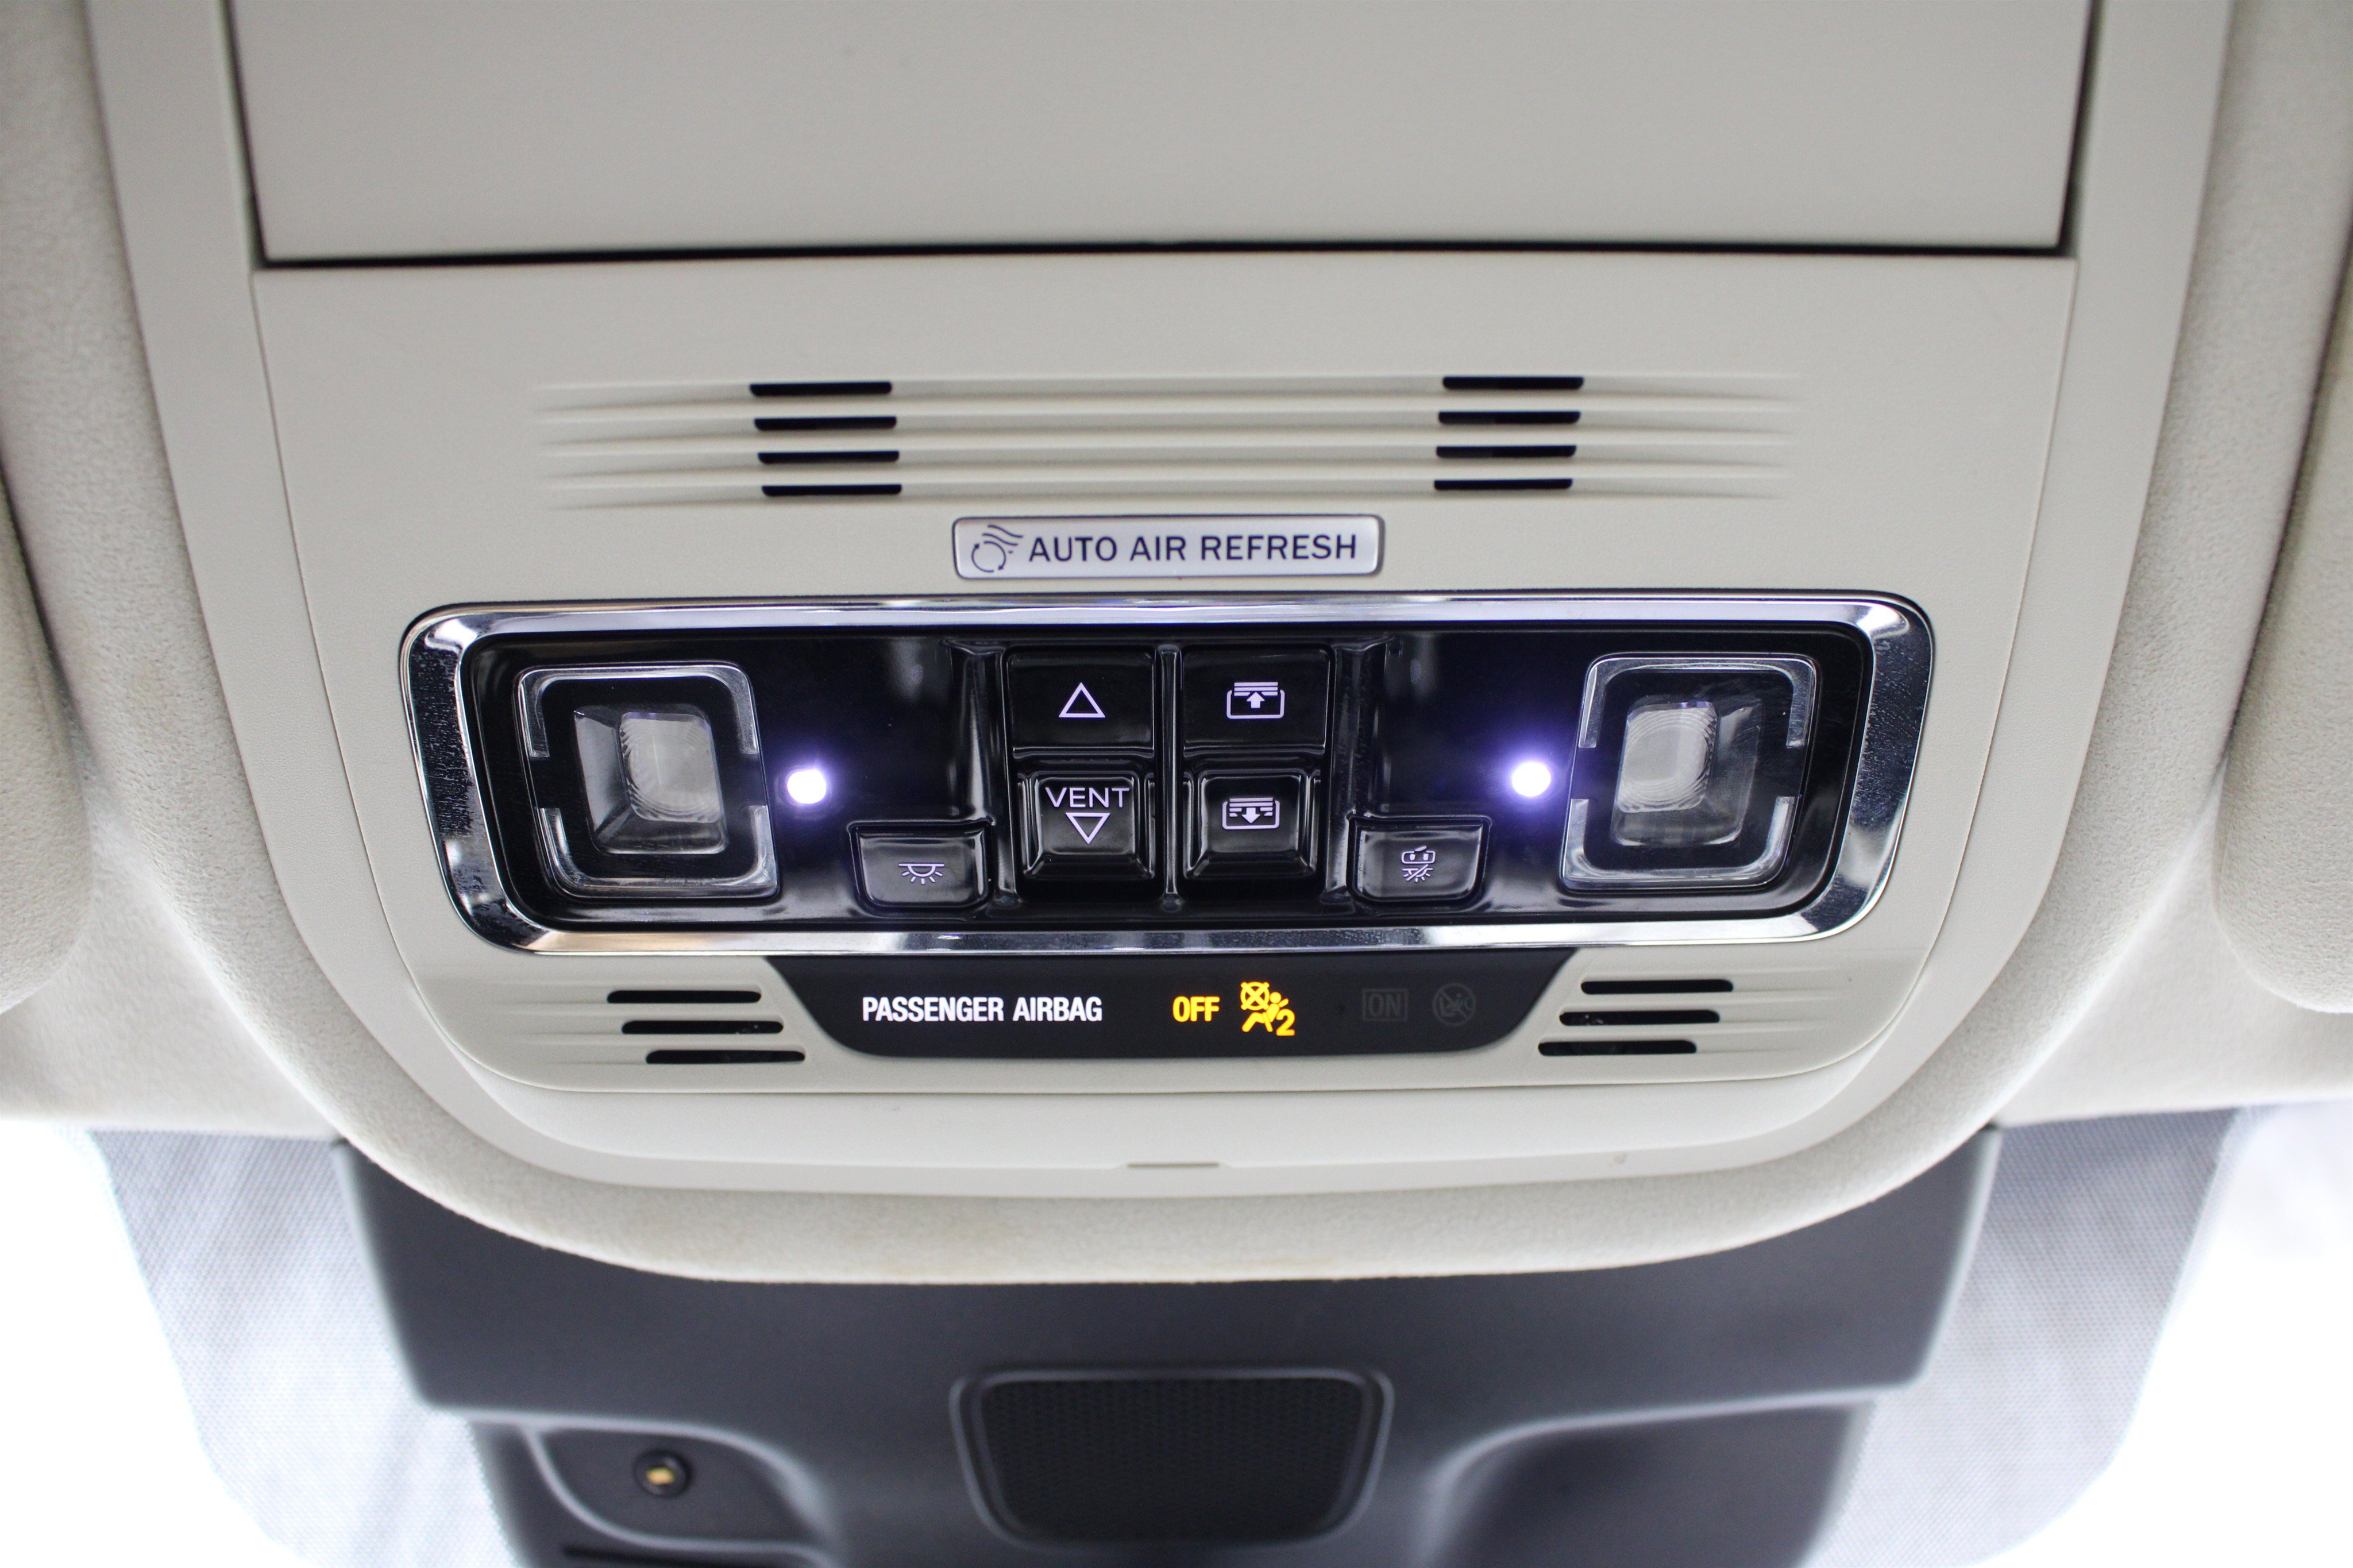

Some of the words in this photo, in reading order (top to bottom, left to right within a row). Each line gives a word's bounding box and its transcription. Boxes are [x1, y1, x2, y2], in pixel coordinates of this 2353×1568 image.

[1029, 536, 1117, 562] AUTO
[1129, 535, 1186, 561] AIR
[1201, 534, 1356, 561] REFRESH
[1045, 787, 1130, 808] VENT
[862, 996, 1004, 1022] PASSENGER
[1012, 996, 1102, 1022] AIRBAG
[1172, 996, 1220, 1022] OFF
[1368, 993, 1403, 1018] ON
[1275, 1009, 1295, 1036] 2
